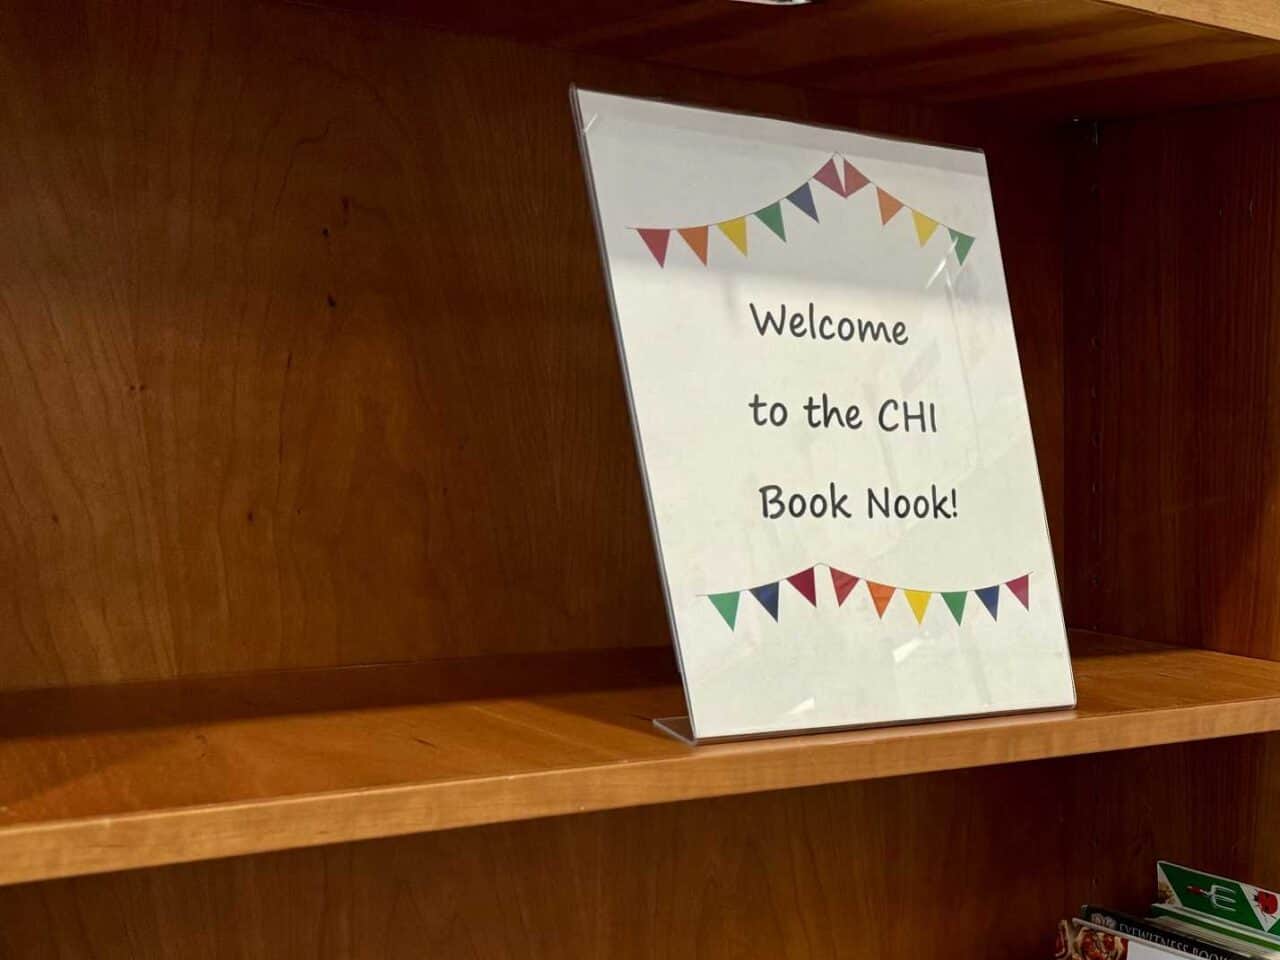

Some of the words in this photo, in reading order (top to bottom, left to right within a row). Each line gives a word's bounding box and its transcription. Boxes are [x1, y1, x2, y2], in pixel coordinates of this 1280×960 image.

[749, 303, 909, 345] Welcome
[748, 393, 789, 428] to
[802, 393, 864, 431] the
[877, 399, 938, 434] CHI
[758, 482, 853, 520] Book
[866, 484, 960, 520] Nook!
